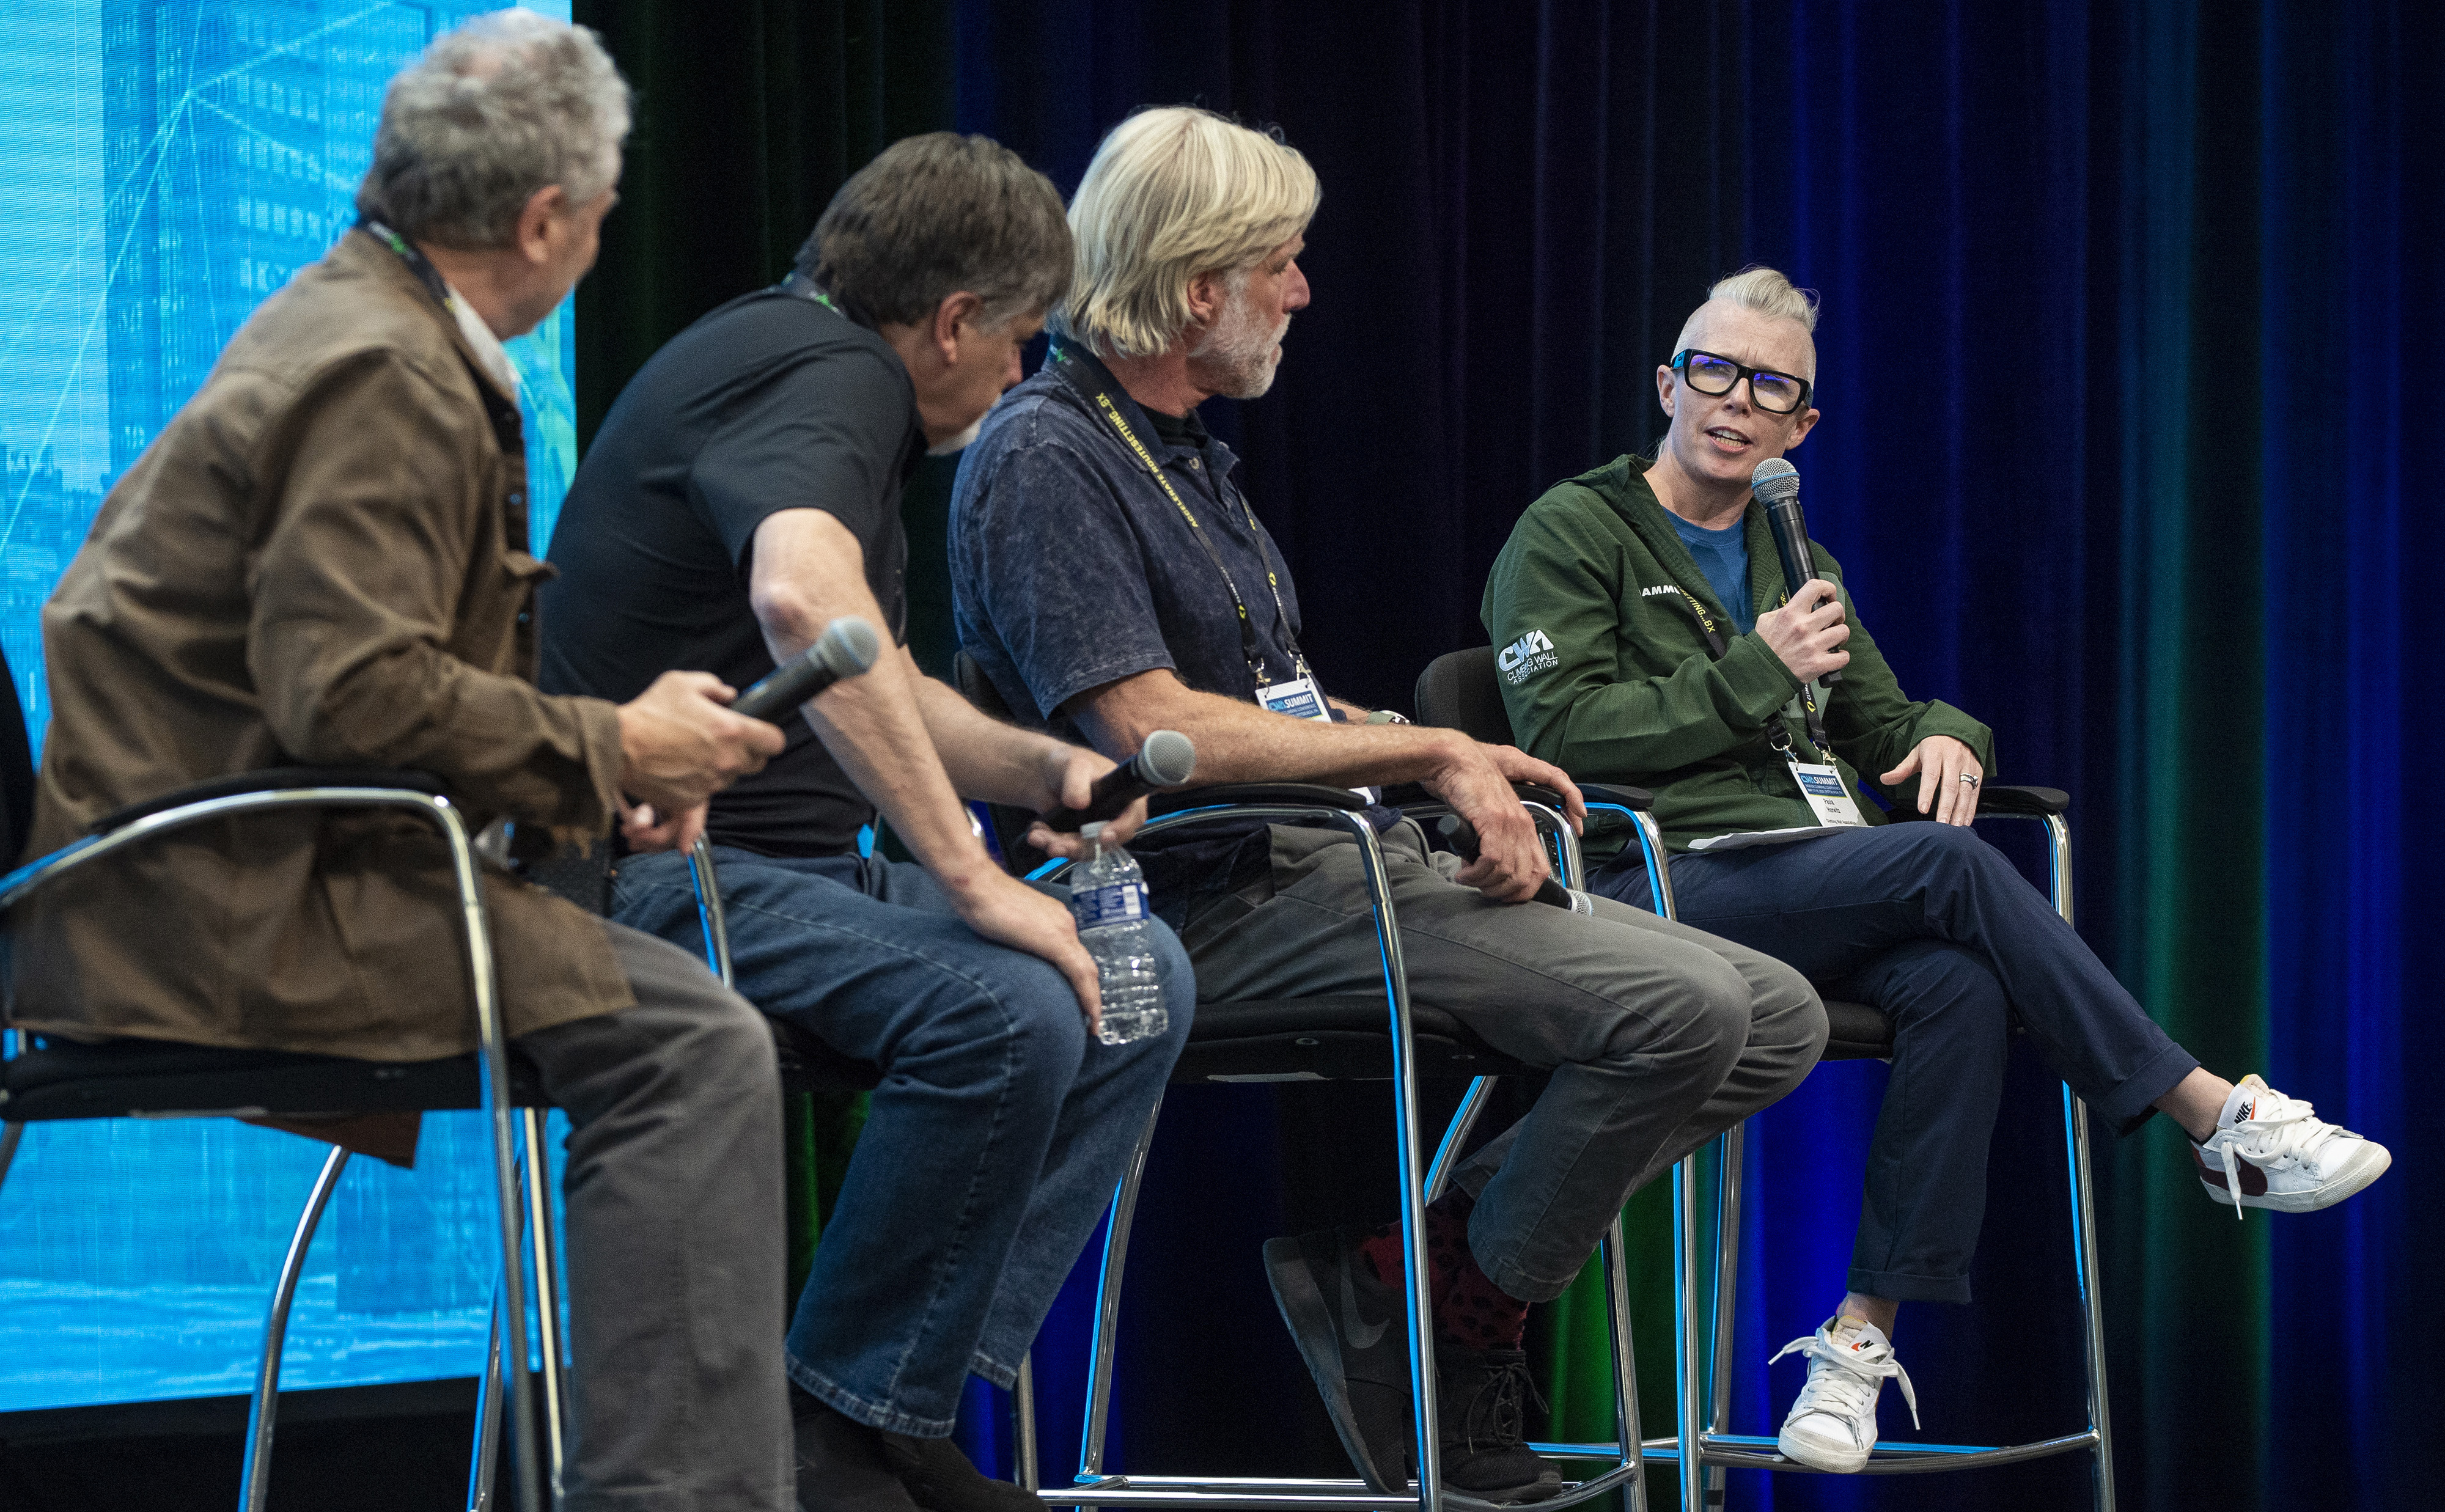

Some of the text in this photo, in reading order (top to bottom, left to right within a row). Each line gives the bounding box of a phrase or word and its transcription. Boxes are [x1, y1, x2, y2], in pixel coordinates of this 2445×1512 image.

[1157, 473, 1199, 527] ACCELERATE
[1498, 629, 1554, 671] CWA
[1507, 651, 1558, 681] CLIMBING WALL
[1513, 659, 1558, 684] ASSOCIATION
[1284, 694, 1314, 708] SUMMIT
[1814, 776, 1837, 785] SUMMIT
[2234, 1101, 2252, 1125] NIKE
